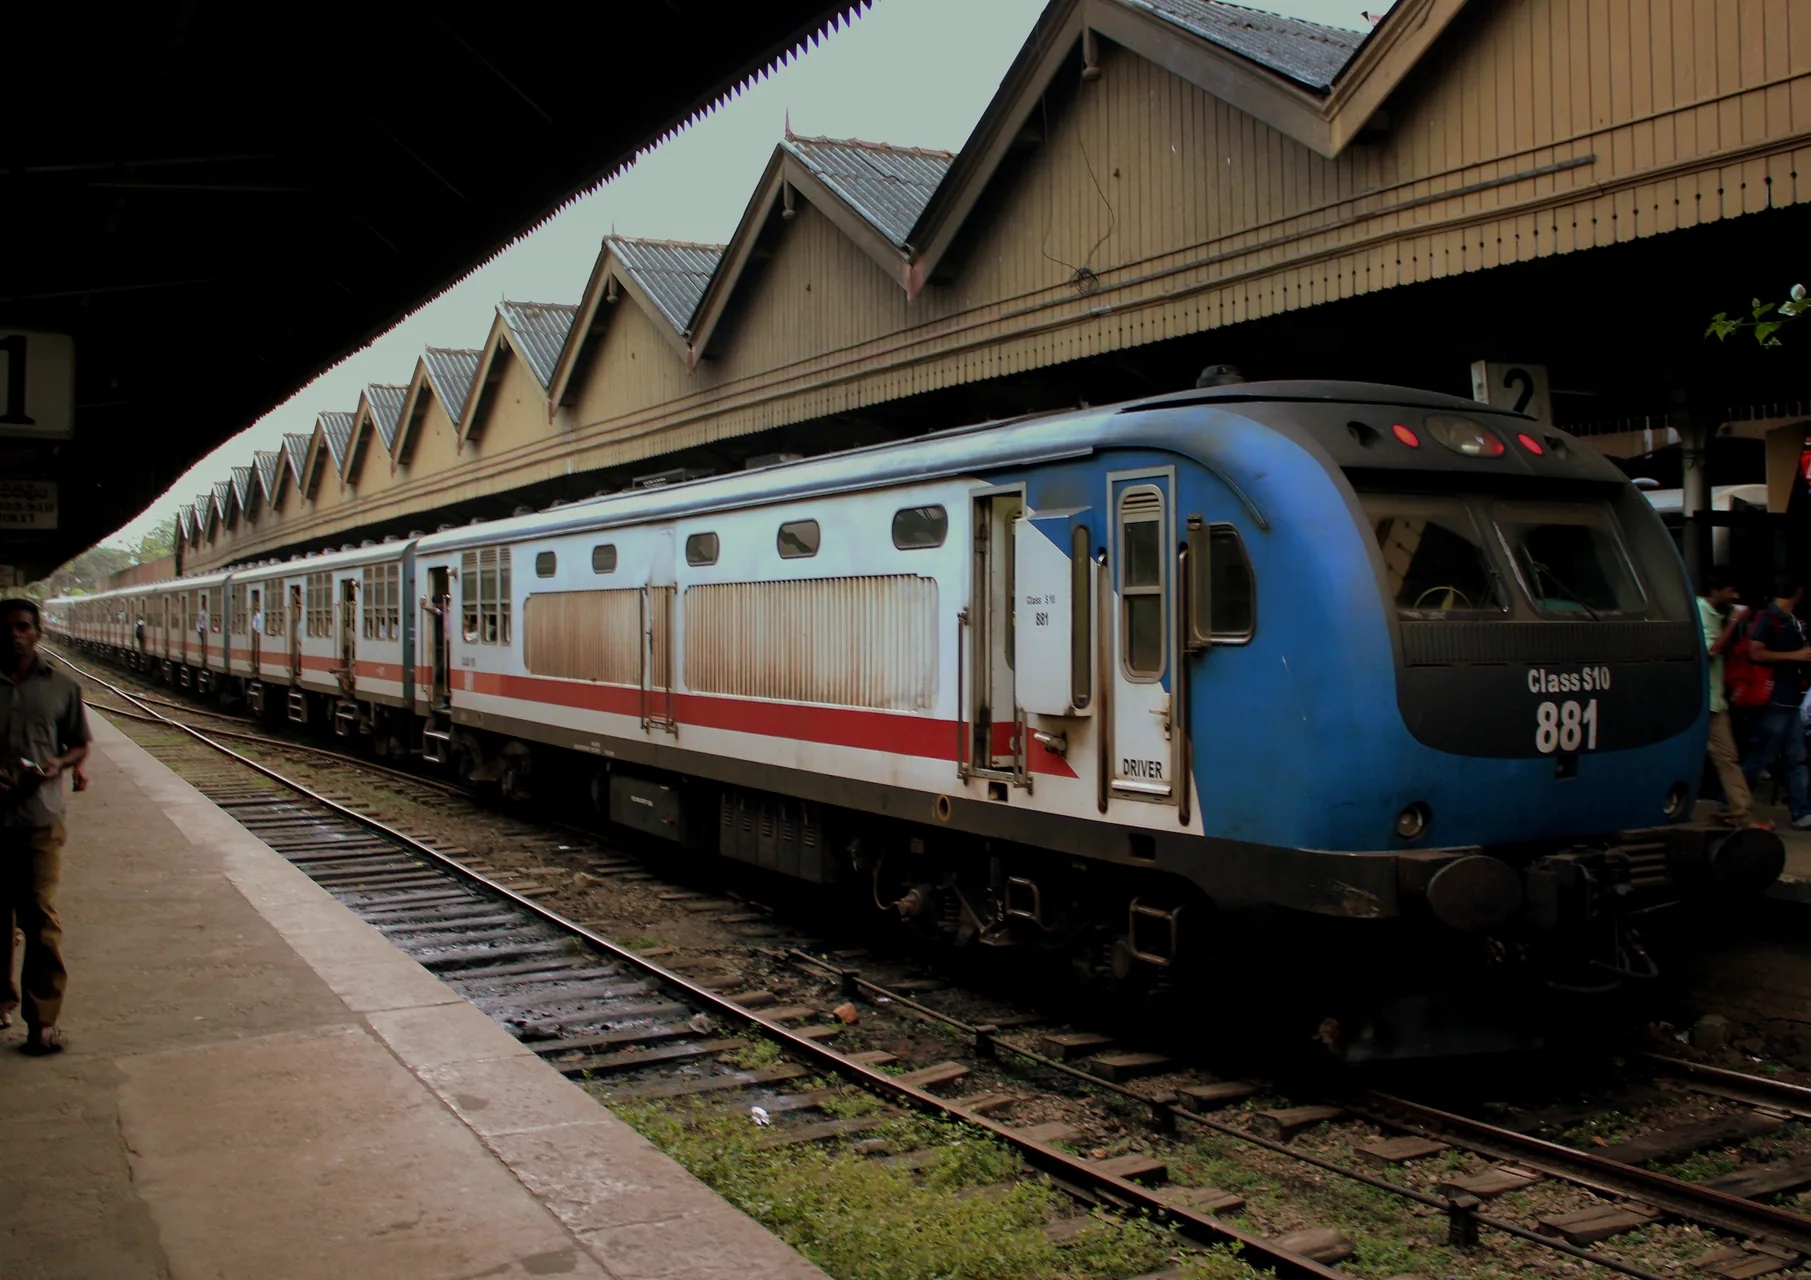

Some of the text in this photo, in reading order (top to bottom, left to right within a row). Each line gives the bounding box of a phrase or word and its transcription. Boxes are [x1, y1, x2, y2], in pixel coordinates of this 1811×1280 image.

[0, 334, 36, 424] 1
[1504, 368, 1533, 414] 2
[1036, 611, 1049, 626] 881
[1528, 666, 1611, 693] Class S10
[1535, 699, 1598, 754] 881
[1123, 758, 1162, 779] DRIVER
